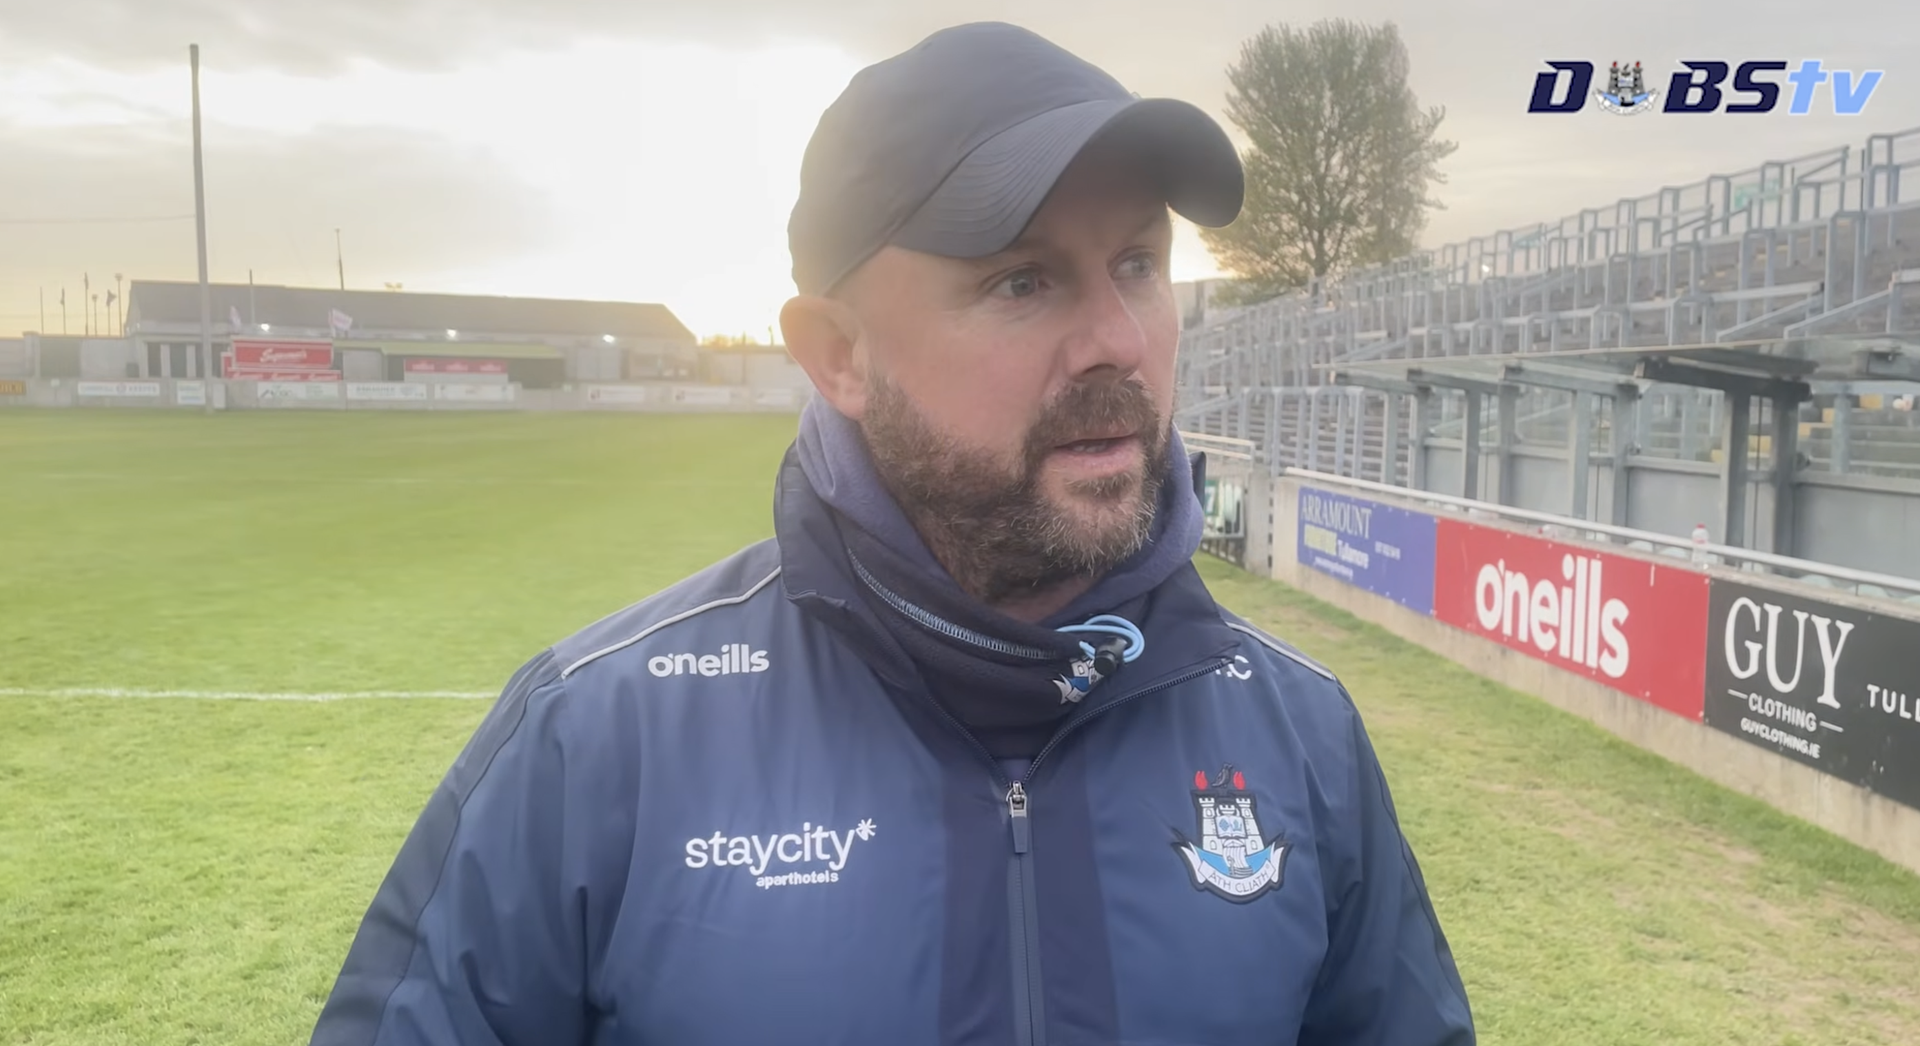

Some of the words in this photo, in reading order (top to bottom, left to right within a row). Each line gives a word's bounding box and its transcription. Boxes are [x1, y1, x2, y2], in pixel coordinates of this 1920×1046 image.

[1301, 495, 1372, 540] ARRAMOUNT
[1725, 596, 1855, 709] GUY
[1748, 692, 1818, 733] CLOTHING
[1740, 717, 1821, 760] GUYCLOTHING.IE
[755, 870, 839, 889] aparthotels
[1208, 870, 1232, 891] ATH
[1234, 869, 1270, 893] CLIATH
